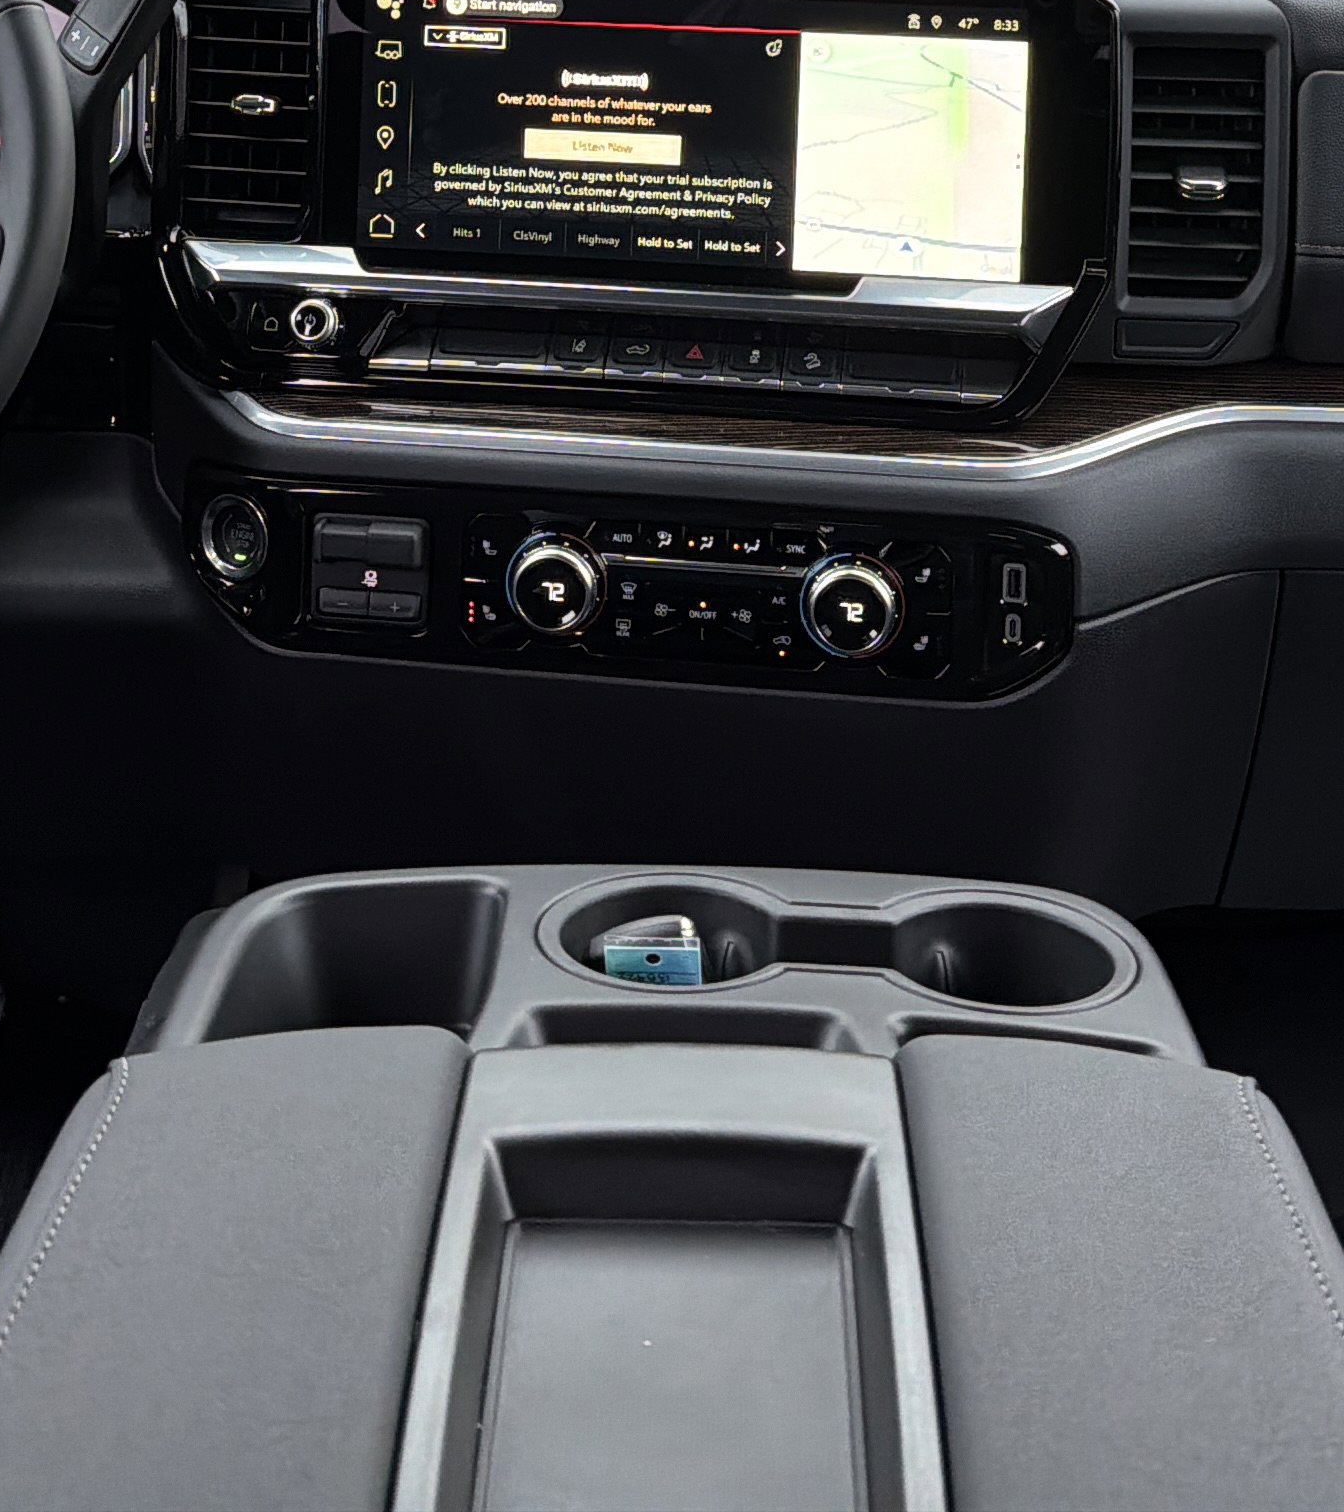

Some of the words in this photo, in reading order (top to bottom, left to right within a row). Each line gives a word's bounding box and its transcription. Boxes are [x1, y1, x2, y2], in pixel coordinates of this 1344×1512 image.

[469, 0, 496, 12] Start
[498, 0, 557, 16] navigation
[958, 17, 980, 30] 47°
[993, 19, 1019, 32] 8:33
[498, 93, 524, 105] Over
[525, 93, 547, 106] 200
[548, 95, 596, 108] channels
[598, 97, 611, 108] of
[611, 98, 660, 111] whatever
[661, 102, 687, 115] your
[688, 103, 712, 114] ears
[551, 114, 569, 124] are
[571, 113, 581, 124] in
[582, 113, 601, 125] the
[603, 114, 637, 126] mood
[637, 115, 656, 127] for.
[572, 140, 605, 152] Listen
[608, 142, 633, 155] Now
[433, 163, 447, 176] By
[449, 164, 490, 179] clicking
[493, 166, 526, 178] Listen
[529, 168, 557, 181] Now,
[558, 171, 579, 183] you
[582, 172, 613, 185] agree
[615, 170, 638, 182] that
[639, 174, 664, 186] your
[667, 174, 690, 185] trial
[692, 175, 760, 190] subscription
[763, 178, 773, 189] is
[434, 180, 486, 194] governed
[488, 181, 502, 194] by
[504, 182, 561, 195] SiriusXM's
[564, 184, 617, 197] Customer
[619, 187, 681, 202] Agreement
[683, 191, 692, 201] &
[695, 191, 734, 205] Privacy
[737, 193, 771, 207] Policy
[467, 196, 499, 208] which
[501, 200, 522, 211] you
[524, 201, 544, 210] can
[545, 200, 571, 211] view
[573, 202, 585, 212] at
[586, 201, 735, 219] siriusxm.com/agreements.
[453, 226, 473, 238] Hits
[577, 232, 620, 248] Highway
[637, 236, 661, 248] Hold
[663, 238, 674, 248] to
[676, 238, 692, 249] Set
[704, 240, 728, 251] Hold
[730, 241, 740, 252] to
[743, 242, 761, 253] Set
[612, 533, 633, 544] AUTO
[785, 543, 807, 555] SYNC
[541, 581, 566, 603] 72
[772, 595, 787, 606] A/C
[688, 609, 718, 620] ON/OFF
[839, 601, 865, 623] 72
